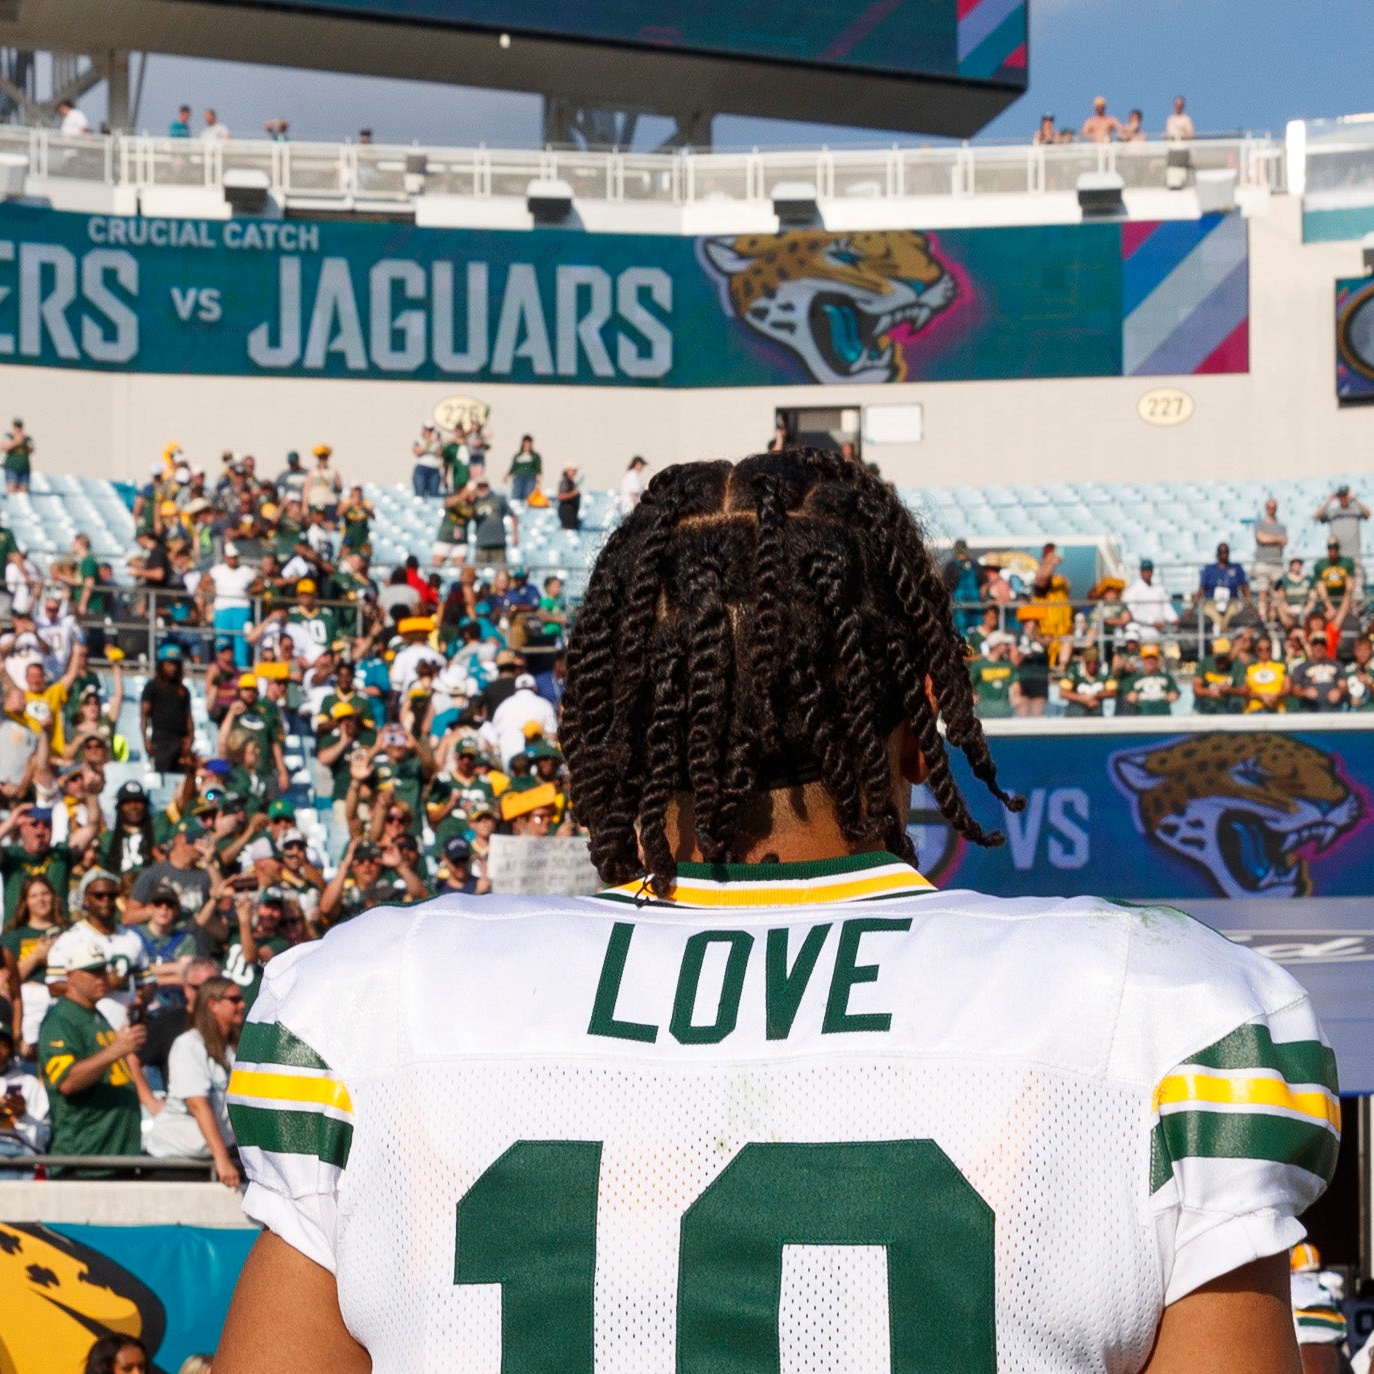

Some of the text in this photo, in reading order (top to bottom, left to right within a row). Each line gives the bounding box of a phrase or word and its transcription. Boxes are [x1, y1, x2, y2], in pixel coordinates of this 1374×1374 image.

[87, 216, 319, 252] CRUCIAL CATCH
[170, 286, 222, 323] VS
[246, 257, 674, 379] JAGUARS
[1147, 396, 1184, 418] 227
[1002, 787, 1091, 871] VS
[587, 917, 913, 1046] LOVE
